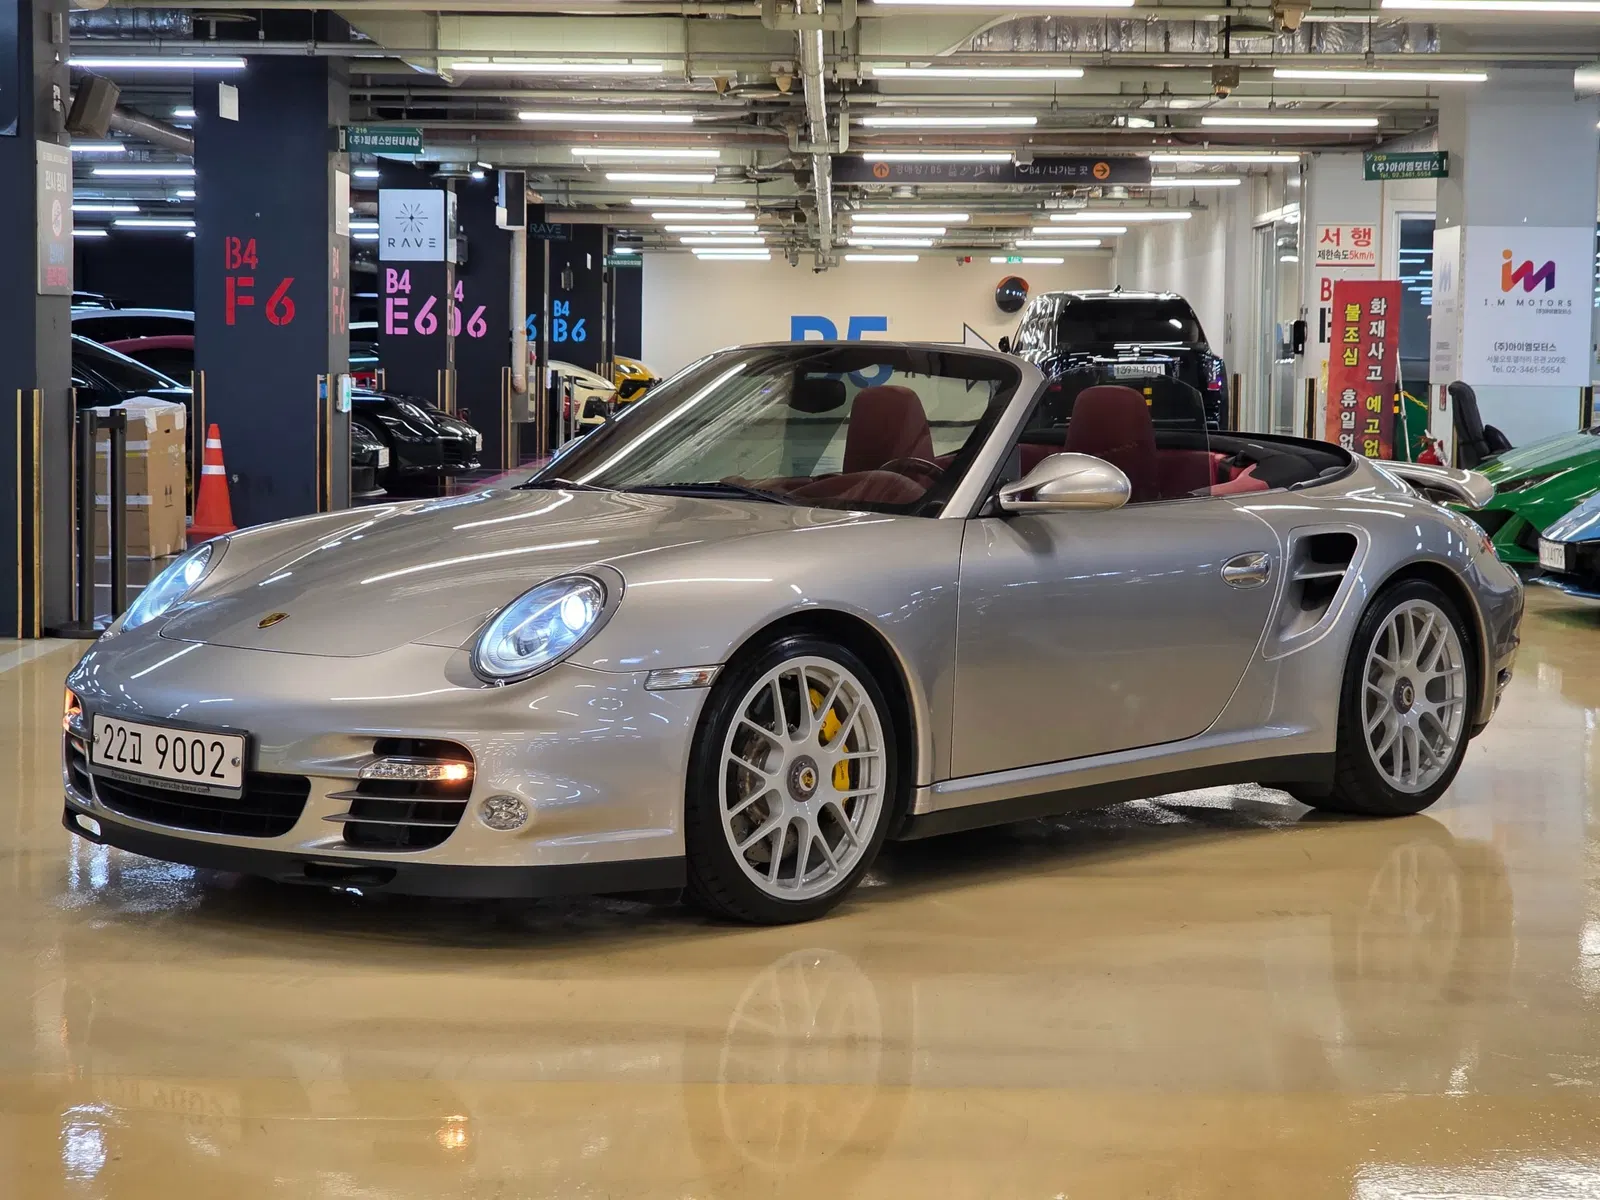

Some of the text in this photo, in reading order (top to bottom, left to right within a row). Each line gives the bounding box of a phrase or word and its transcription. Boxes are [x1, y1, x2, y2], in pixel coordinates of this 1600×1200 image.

[1048, 165, 1076, 176] 나가는
[1372, 161, 1439, 172] (주)아이엠모터스
[225, 236, 259, 270] B4
[386, 267, 412, 294] B4
[385, 295, 438, 335] E6
[553, 300, 570, 317] B4
[1516, 299, 1572, 307] MOTORS
[526, 314, 538, 341] 6
[552, 318, 587, 342] B6
[1343, 303, 1361, 366] 불조심
[1366, 297, 1387, 382] 화재사고
[1494, 342, 1557, 352] (주)아이엠모터스
[1506, 365, 1560, 374] 02-3461-5554
[103, 723, 225, 779] 22고 9002
